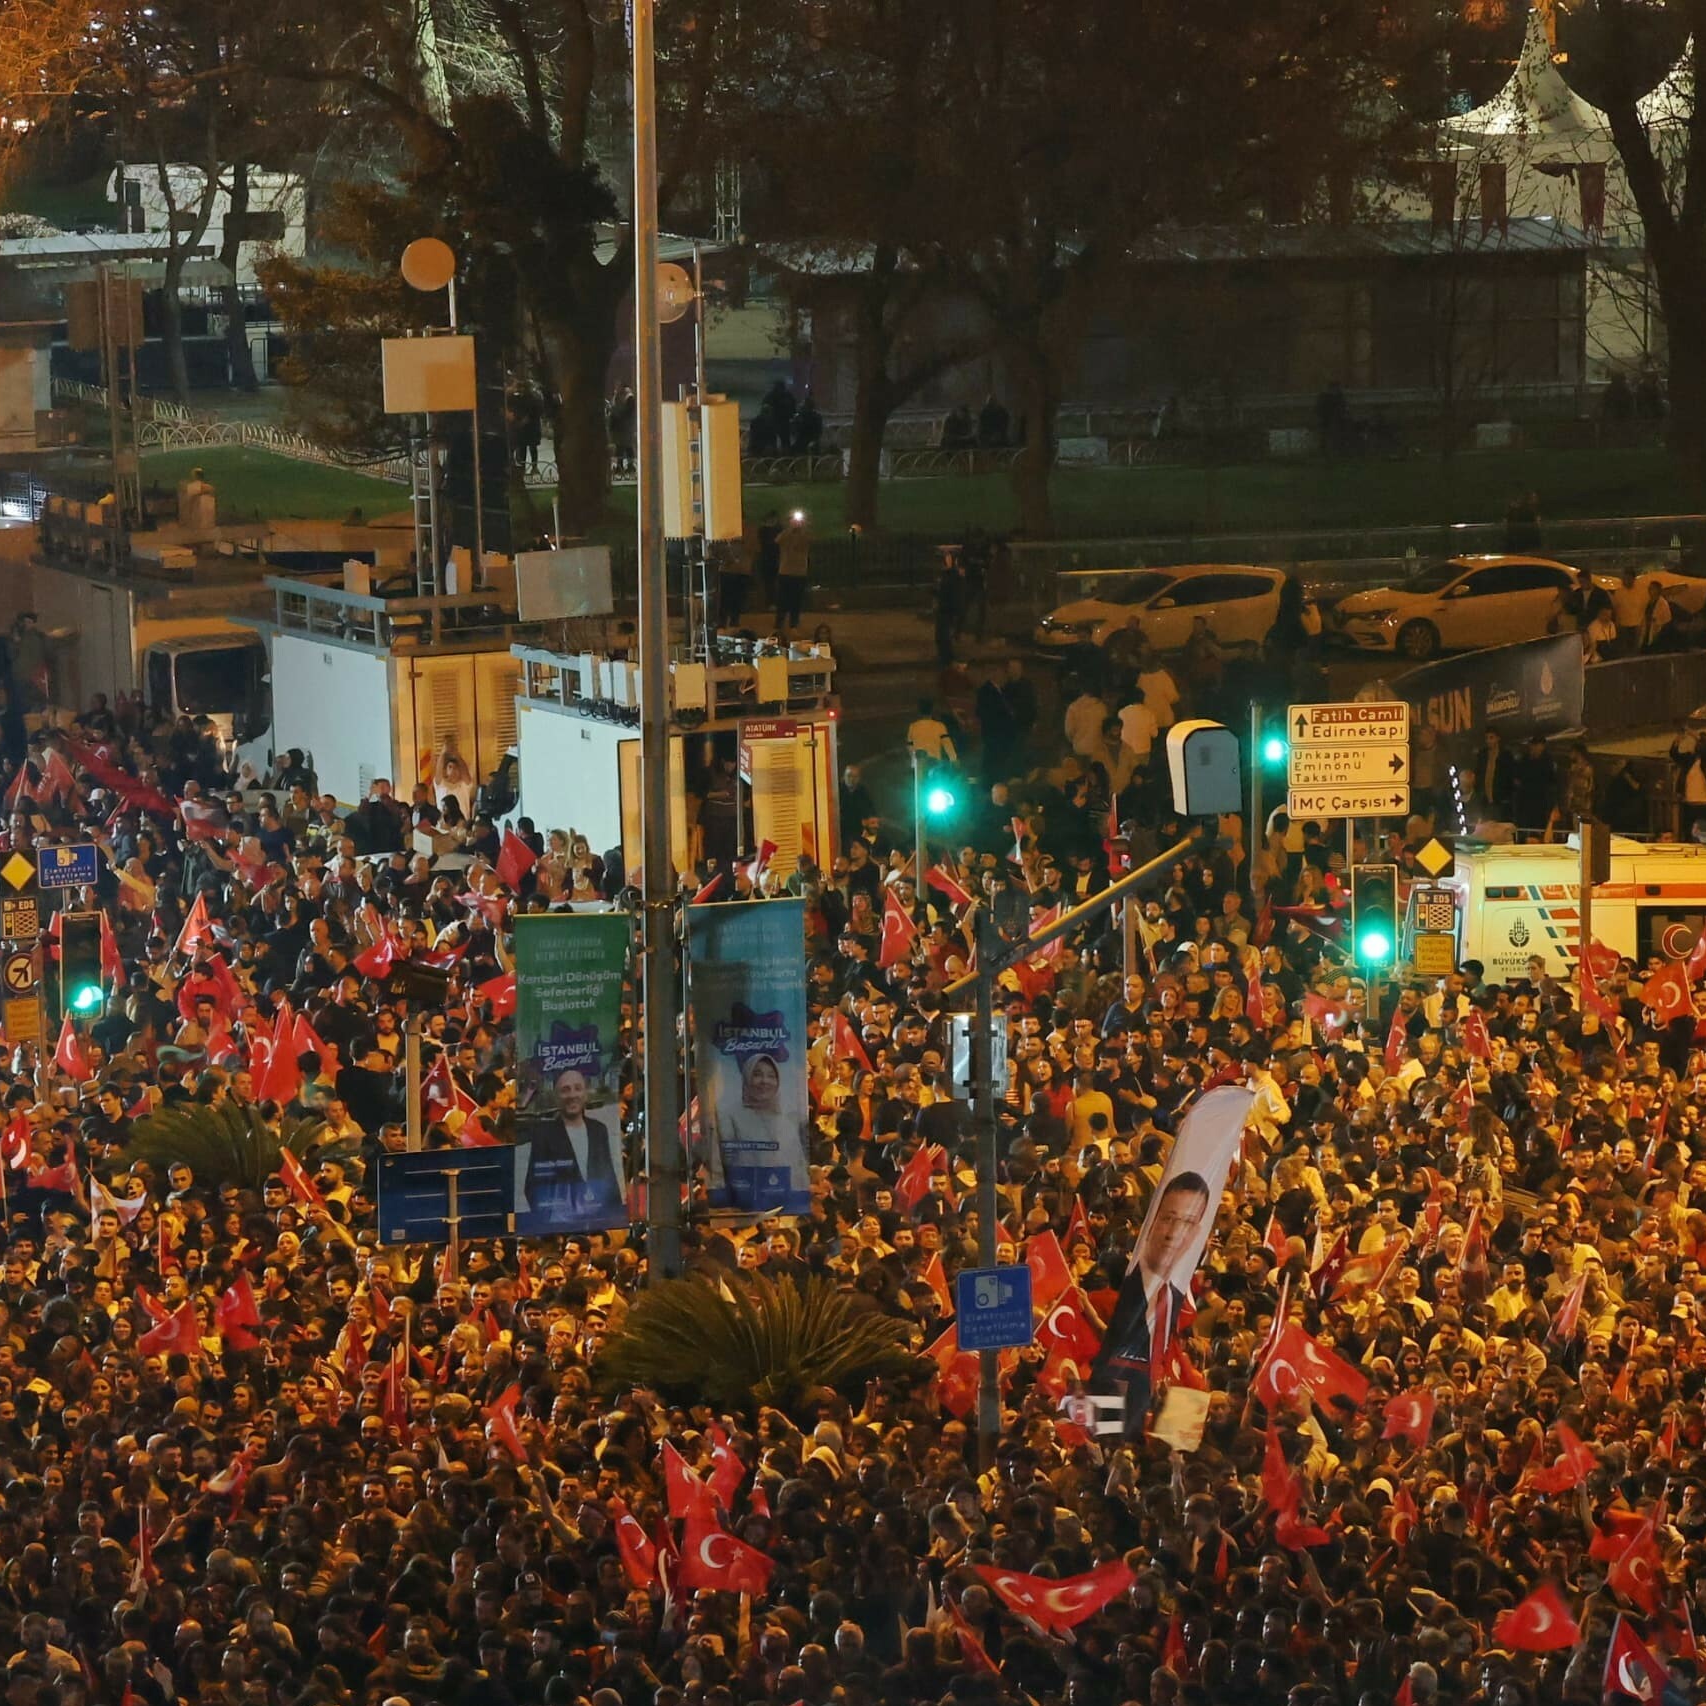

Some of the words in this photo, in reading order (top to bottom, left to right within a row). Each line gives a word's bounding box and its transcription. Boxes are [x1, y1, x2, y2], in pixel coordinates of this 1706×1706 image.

[1312, 709, 1353, 722] Fatih
[1312, 724, 1403, 739] Edirnekapı
[1294, 750, 1365, 761] Unkapanı
[1294, 760, 1362, 771] Eminönü
[1294, 773, 1348, 783] Taksim
[1293, 794, 1326, 812] İMÇ
[1331, 795, 1386, 812] Çarşısı
[1433, 894, 1451, 904] EDS
[18, 900, 35, 911] EDS
[718, 1023, 788, 1039] İSTANBUL
[538, 1041, 600, 1058] İSTANBUL
